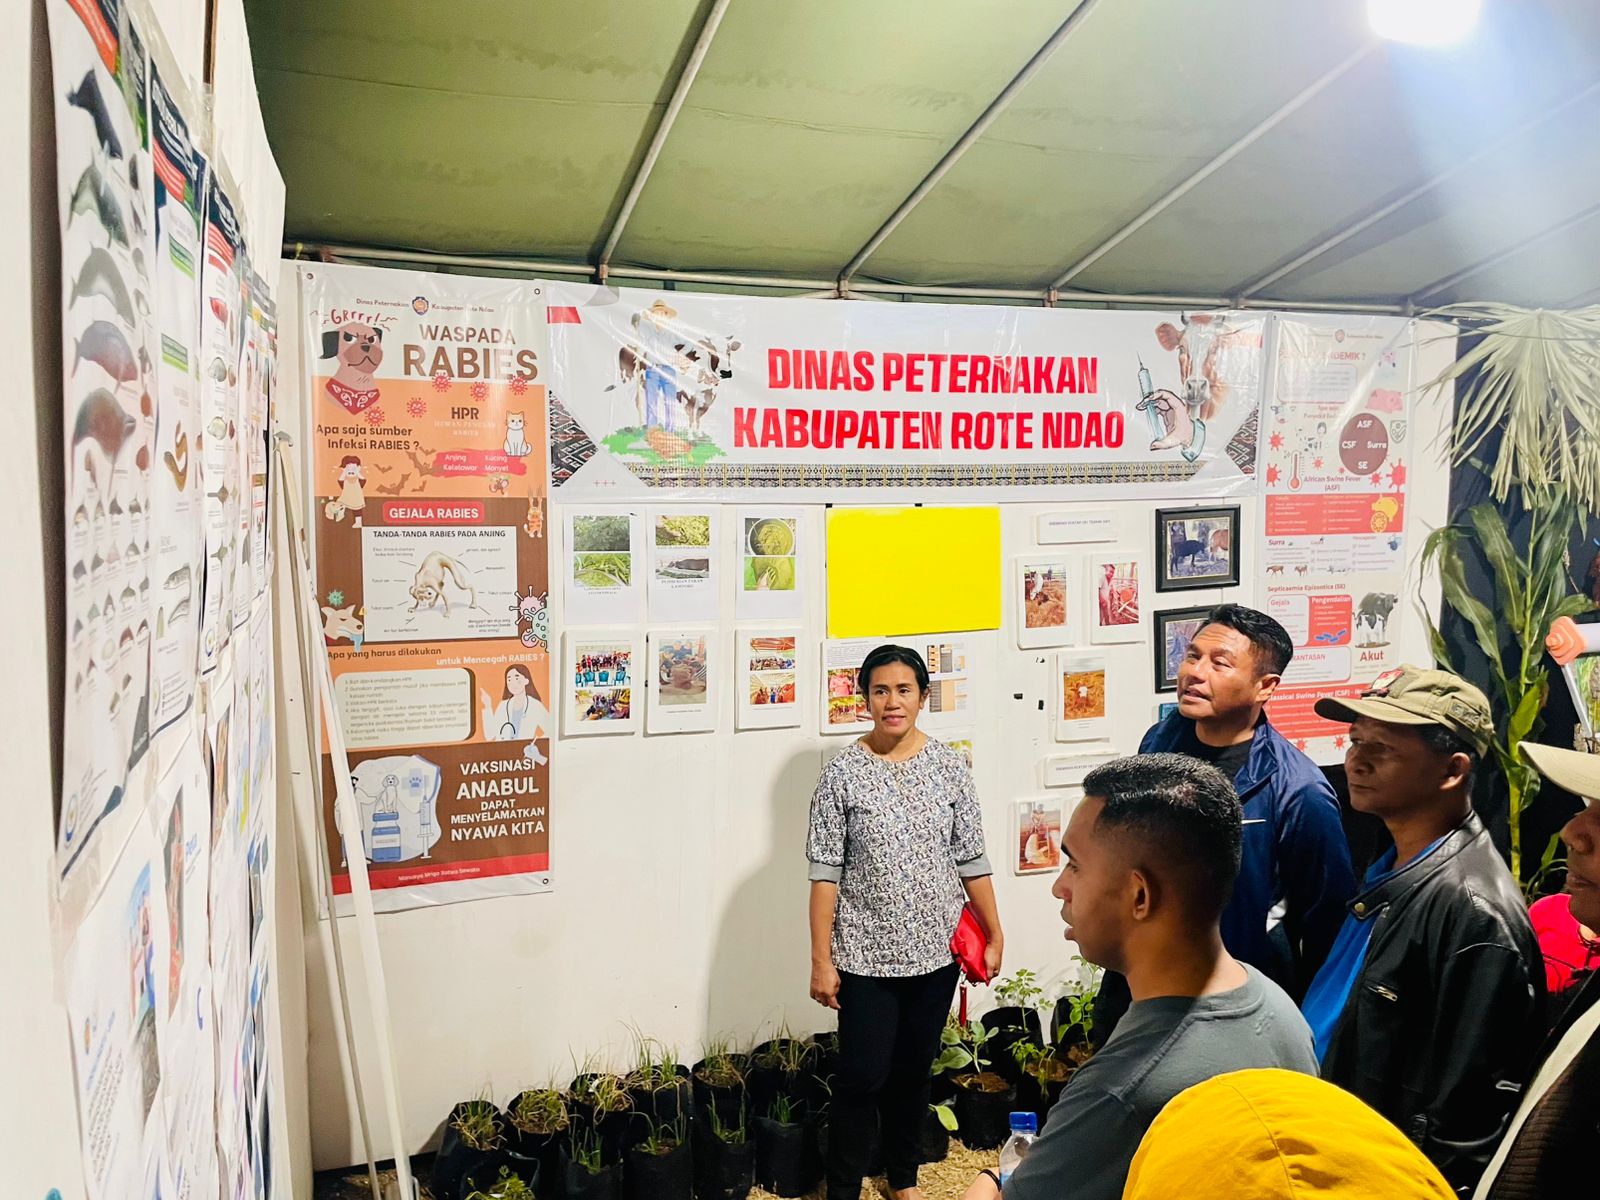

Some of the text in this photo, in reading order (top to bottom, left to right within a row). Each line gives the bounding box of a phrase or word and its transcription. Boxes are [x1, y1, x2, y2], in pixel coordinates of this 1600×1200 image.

[420, 324, 516, 345] WASPADA
[404, 344, 538, 381] RABIES
[768, 348, 1098, 394] DINAS PETERNAKAN
[451, 406, 480, 420] HPR
[734, 407, 1124, 450] KABUPATEN ROTE NDAO
[1357, 420, 1373, 428] ASF
[316, 425, 412, 437] Apa saja sumber
[328, 438, 420, 450] Infeksi RABIES ?
[1342, 441, 1387, 449] CSF Surra
[444, 454, 467, 463] Anjing
[1358, 460, 1368, 469] SE
[1324, 484, 1340, 492] (ASF)
[389, 508, 479, 519] GEJALA RABIES
[374, 530, 428, 538] TANDA-TANDA
[1270, 600, 1290, 608] Gejala
[328, 648, 442, 660] Apa yang harus dilakukan
[436, 656, 462, 666] untuk
[463, 655, 508, 666] Mencegah
[508, 654, 538, 663] RABIES
[1360, 651, 1384, 662] Akut
[1317, 692, 1334, 700] Fever
[460, 758, 536, 776] VAKSINASI
[456, 777, 540, 800] ANABUL
[480, 799, 516, 811] DAPAT
[451, 807, 545, 824] MENYELAMATKAN
[451, 822, 545, 842] NYAWA KITA
